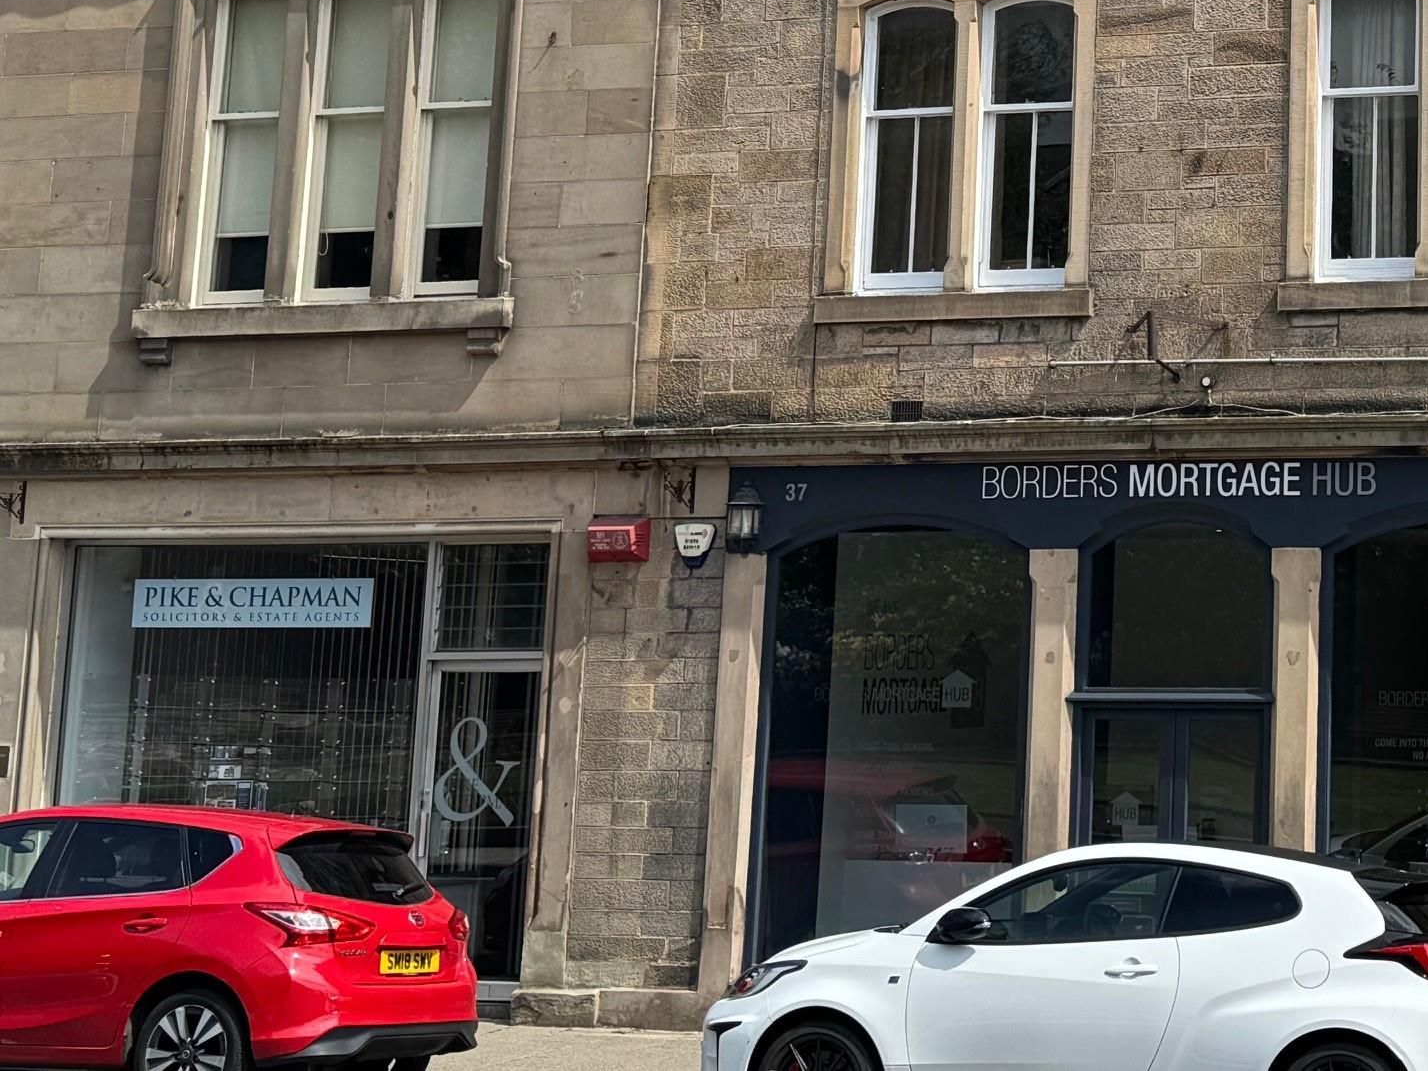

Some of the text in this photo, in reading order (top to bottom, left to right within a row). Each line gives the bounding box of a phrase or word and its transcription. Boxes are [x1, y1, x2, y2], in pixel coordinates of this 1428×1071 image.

[981, 462, 1377, 499] BORDERS MORTGAGE HUB
[784, 483, 808, 502] 37
[144, 585, 362, 608] PIKE & CHAPMAN
[142, 612, 360, 622] SOLICITORS & ESTATE AGENTS
[945, 687, 970, 702] HUB
[1412, 750, 1424, 761] NO
[433, 717, 521, 827] &
[1115, 806, 1137, 820] HUB
